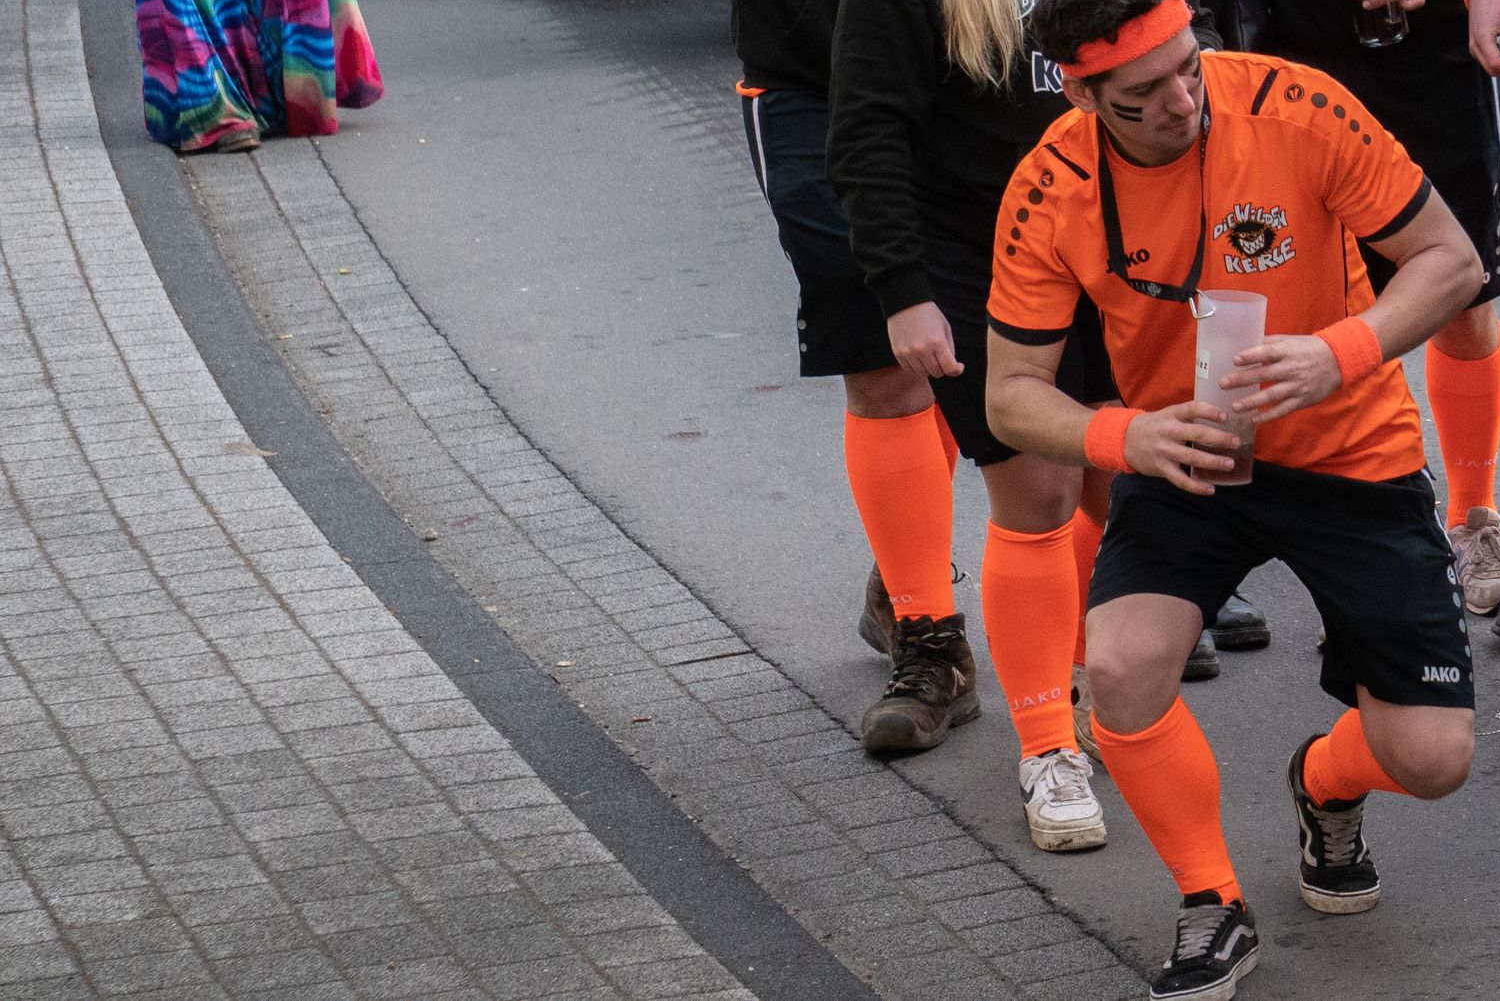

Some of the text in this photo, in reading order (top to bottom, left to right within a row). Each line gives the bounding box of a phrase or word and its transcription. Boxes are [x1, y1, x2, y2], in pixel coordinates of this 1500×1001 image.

[1224, 235, 1296, 274] KERLE
[1422, 666, 1460, 683] JAKO
[1014, 687, 1060, 711] JAKO
